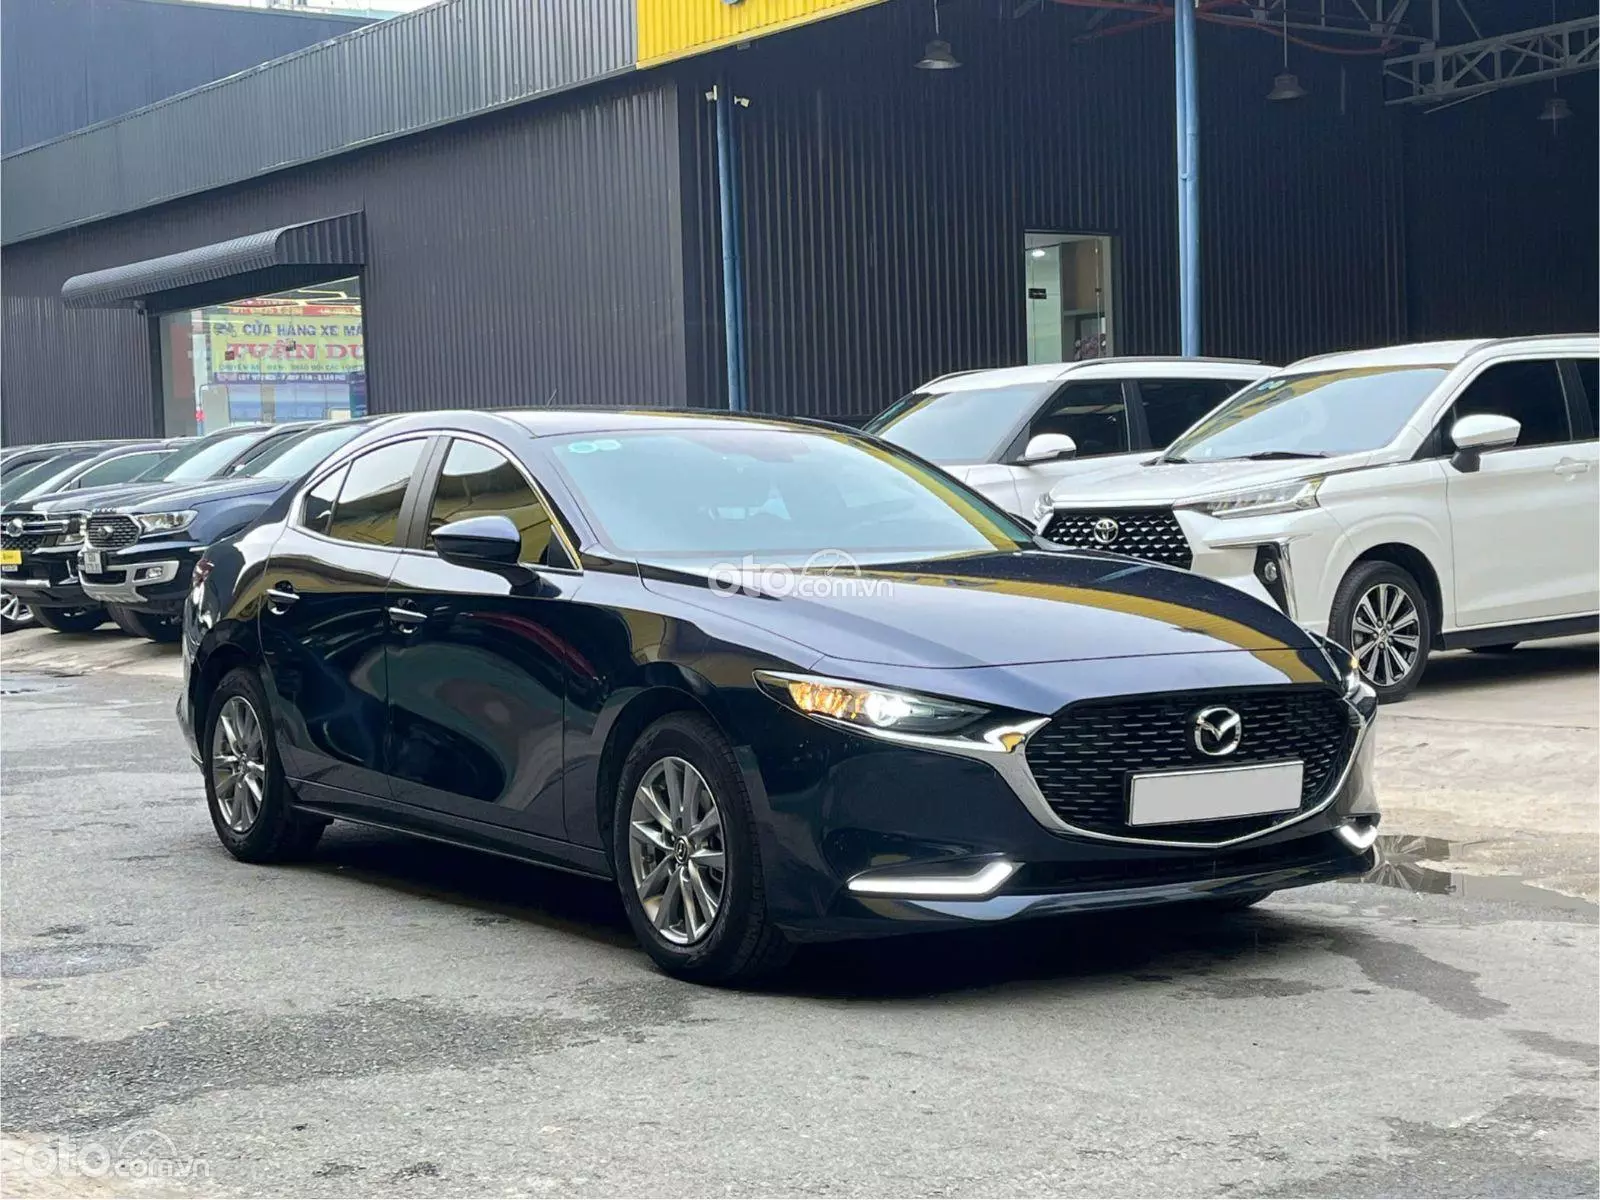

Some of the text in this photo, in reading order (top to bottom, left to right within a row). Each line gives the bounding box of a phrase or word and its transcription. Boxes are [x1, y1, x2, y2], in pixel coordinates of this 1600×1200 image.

[243, 320, 271, 336] CỬA
[277, 322, 316, 336] HÀNG
[320, 324, 338, 336] XE
